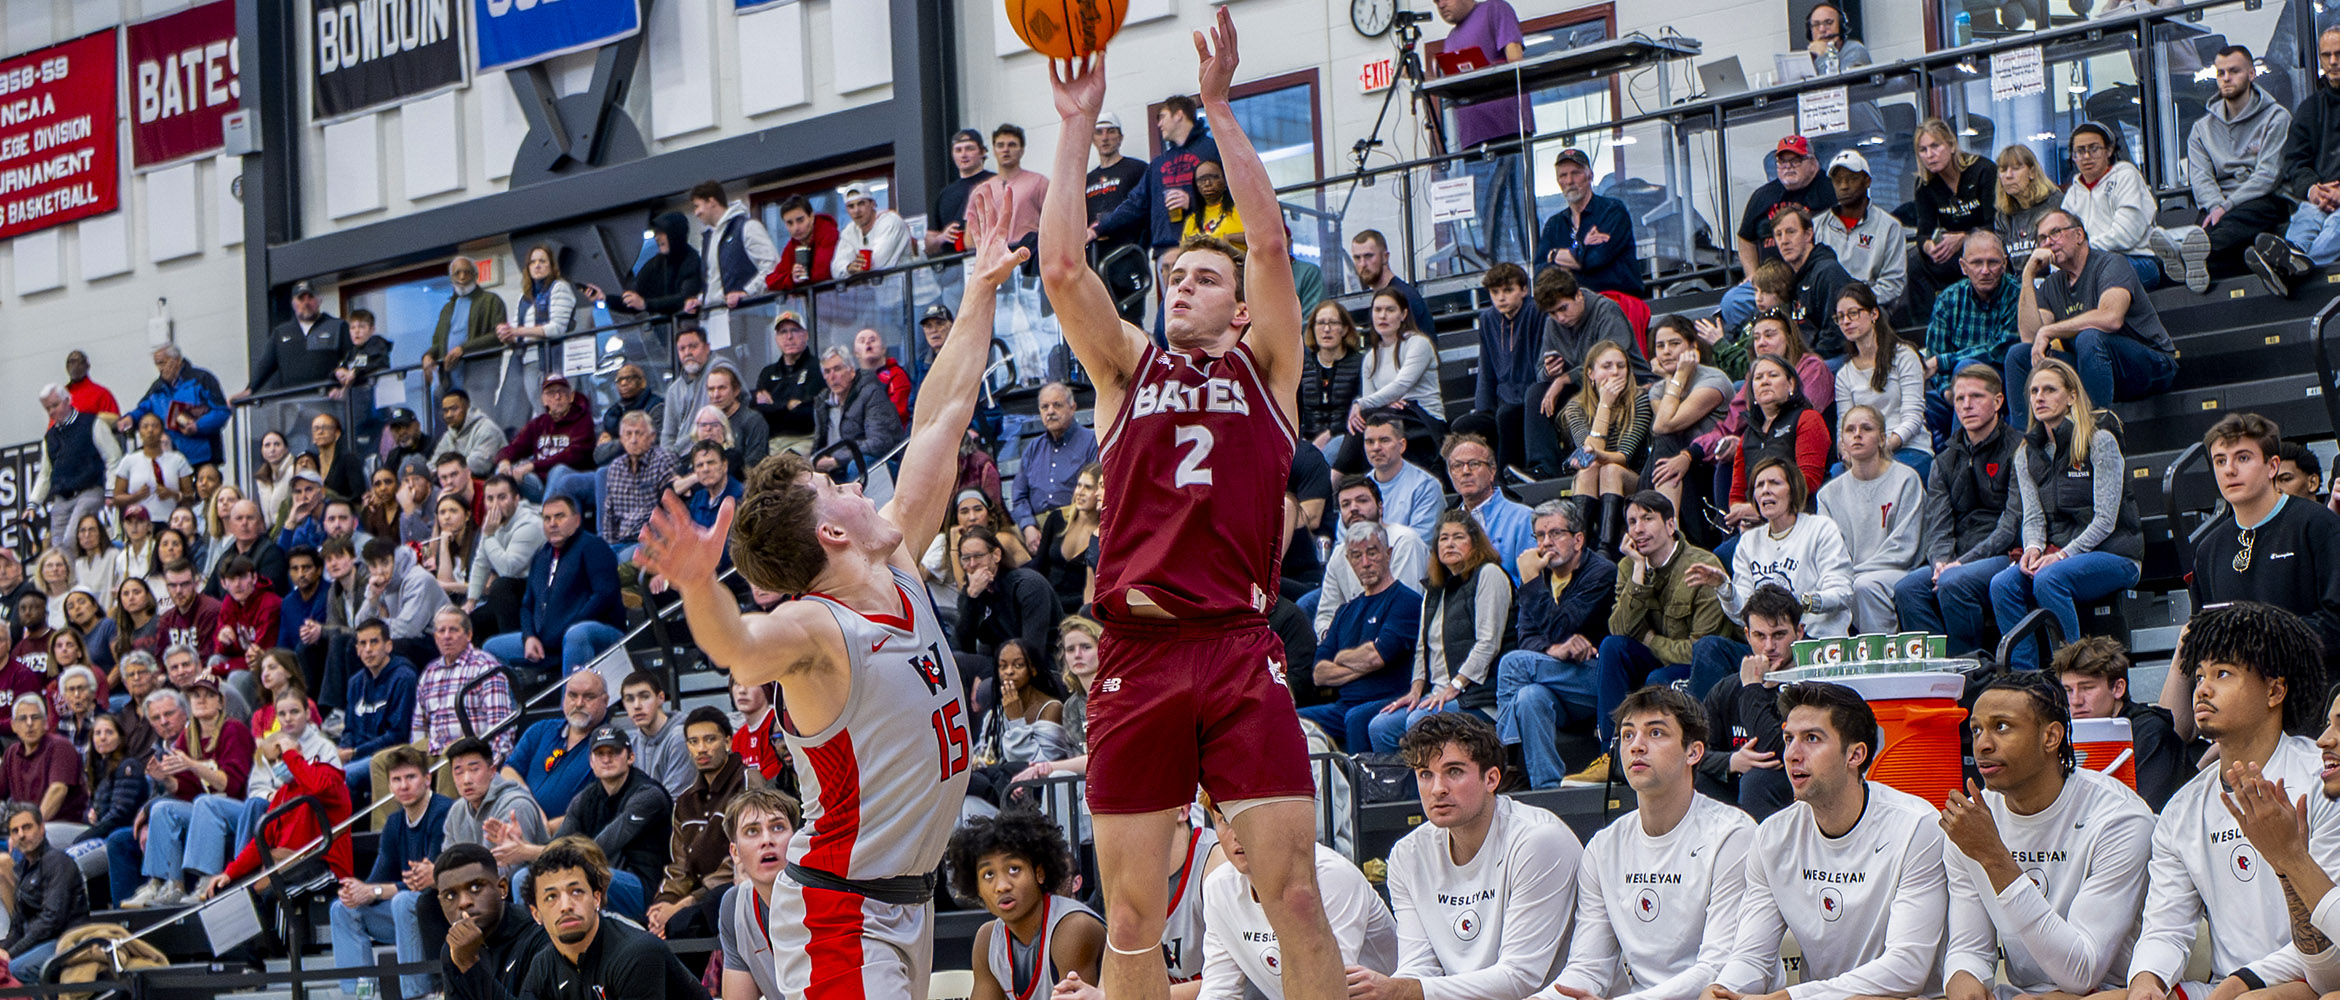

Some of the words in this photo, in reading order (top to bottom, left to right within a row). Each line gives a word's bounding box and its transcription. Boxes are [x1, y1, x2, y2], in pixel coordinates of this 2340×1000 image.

[318, 0, 450, 75] BOWDOIN
[1363, 59, 1391, 90] EXIT
[1, 92, 56, 128] NCAA
[0, 132, 31, 162] EGE
[34, 114, 92, 152] DIVISION
[8, 181, 99, 225] BASKETBALL
[1132, 378, 1251, 419] BATES
[1174, 424, 1215, 489] 2
[1824, 642, 1842, 664] G
[1905, 638, 1924, 661] G
[908, 641, 948, 696] W
[931, 696, 970, 782] 15
[2210, 827, 2247, 844] WESL
[2011, 850, 2068, 863] ESLEYAN
[1624, 872, 1683, 885] WESLEYAN
[1802, 868, 1867, 884] WESLEYAN
[1437, 888, 1496, 906] WESLEYAN
[1242, 930, 1278, 943] WESLE
